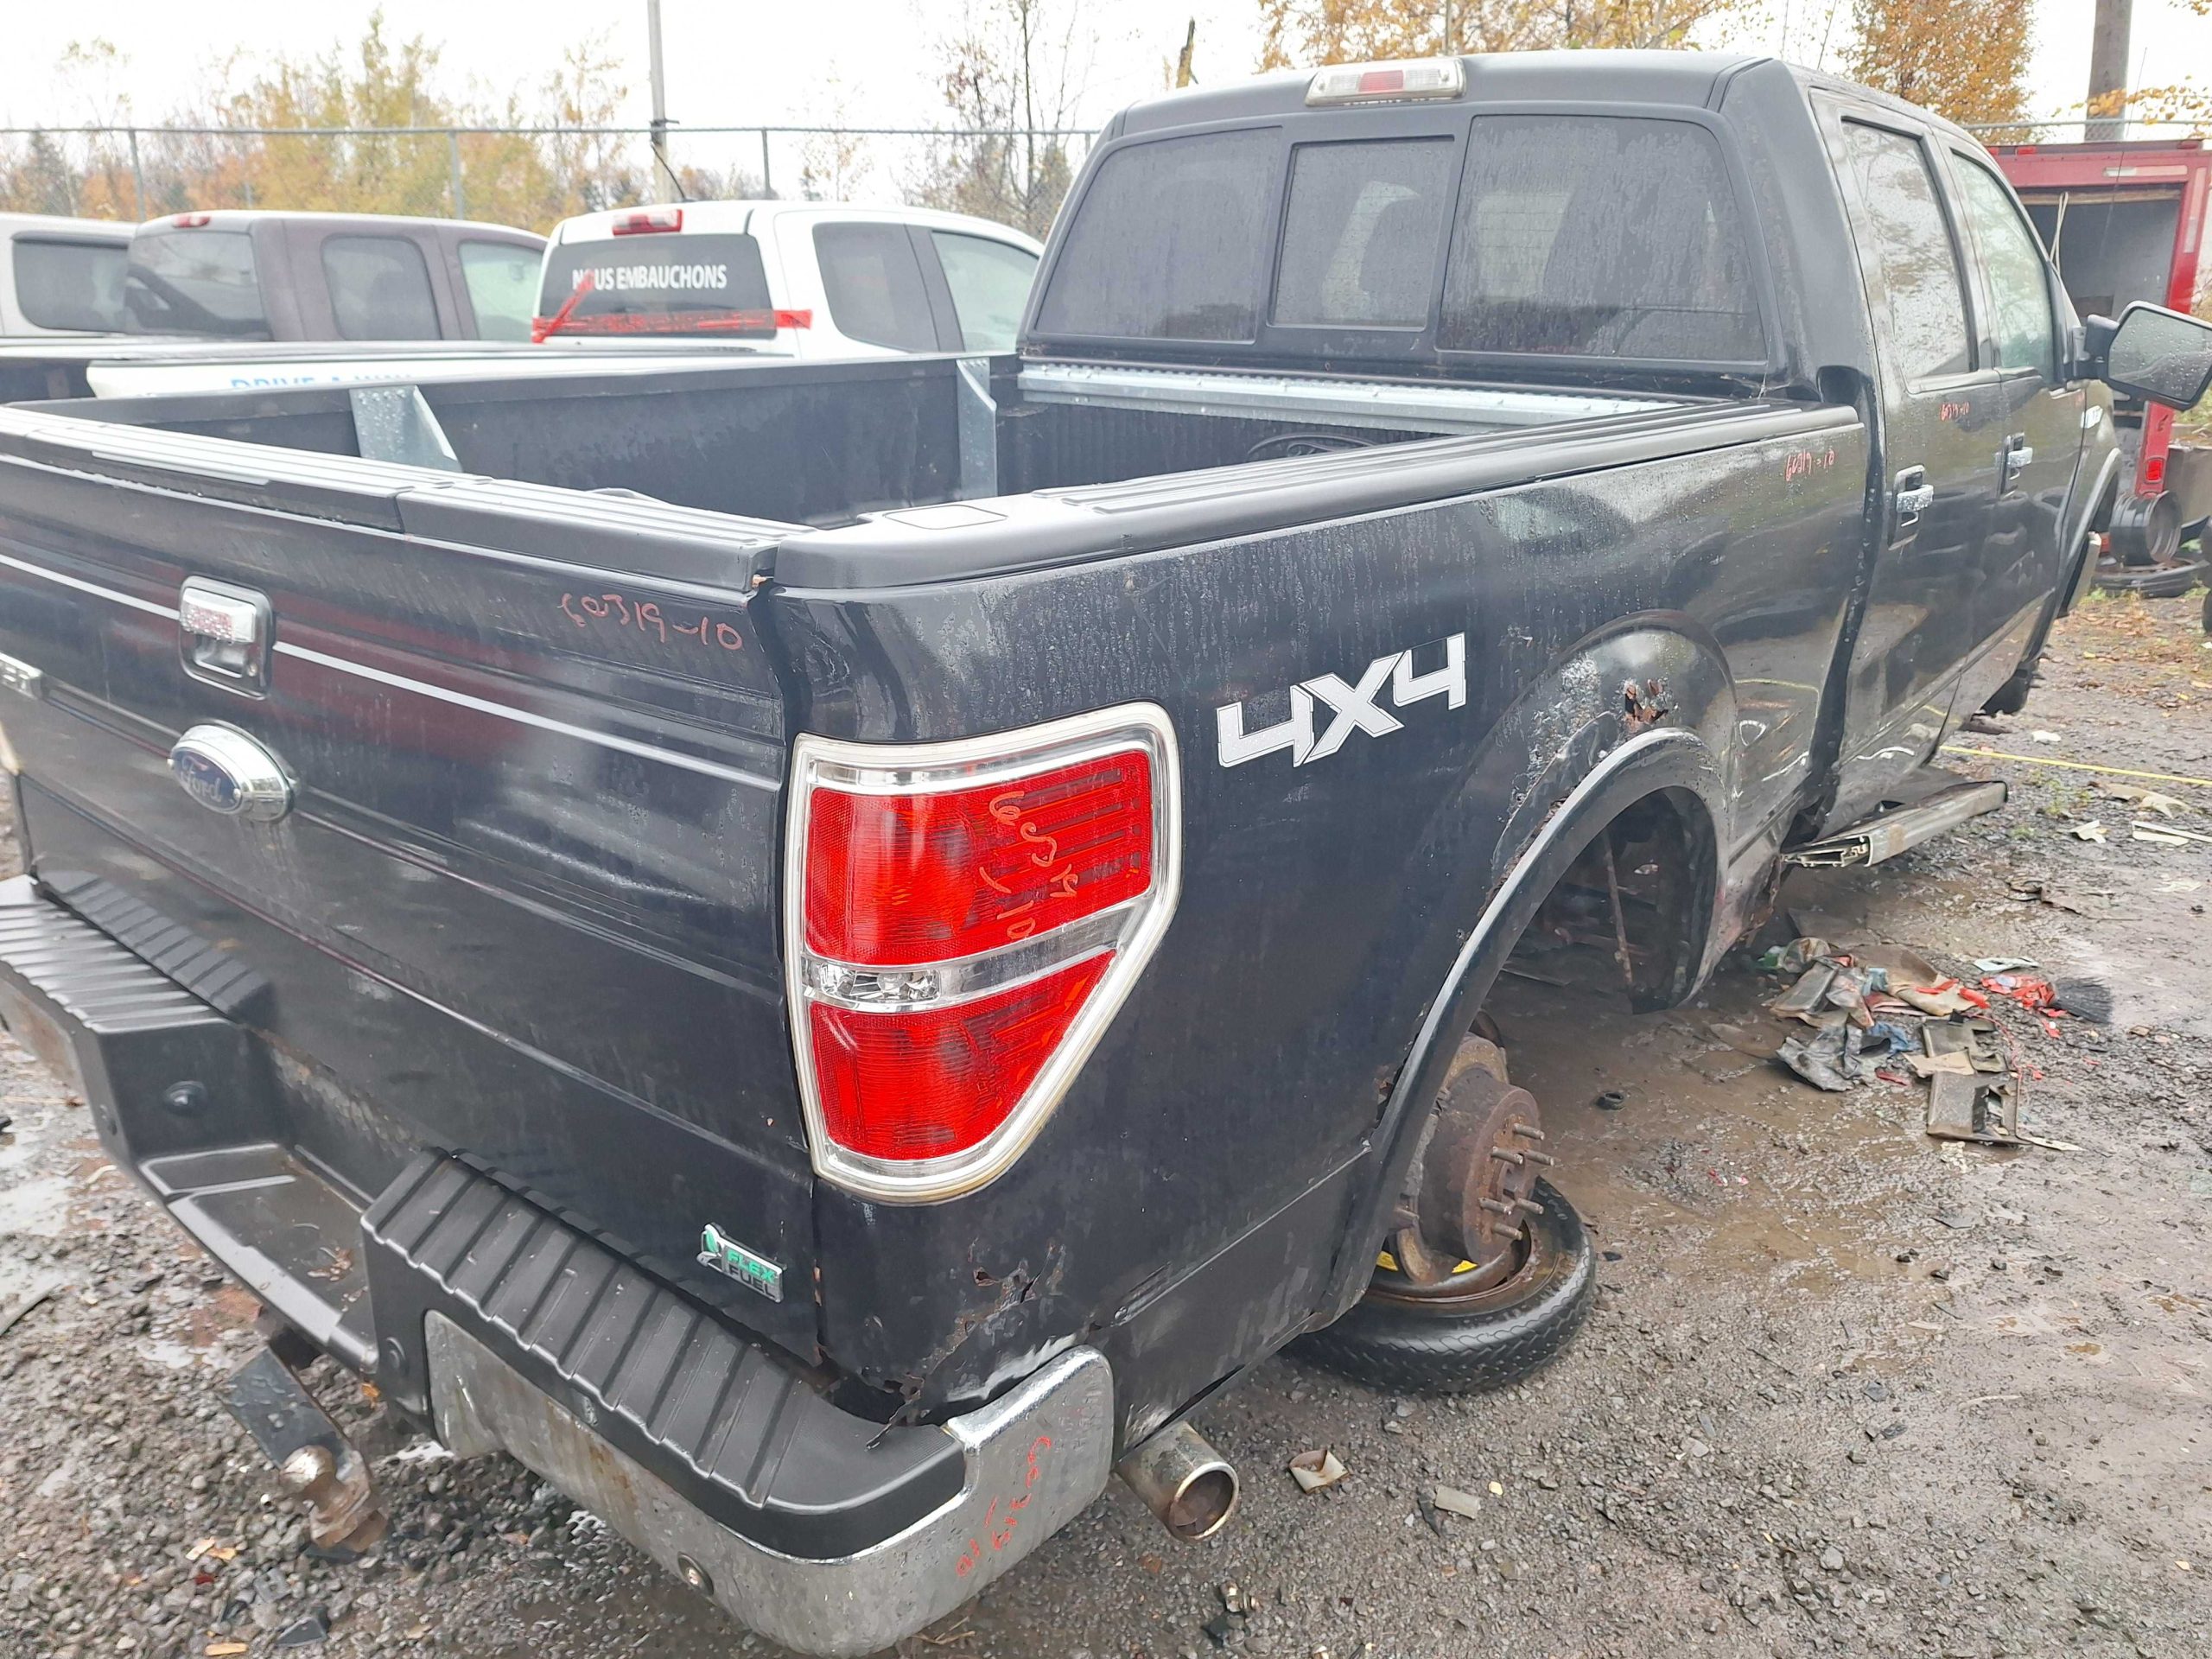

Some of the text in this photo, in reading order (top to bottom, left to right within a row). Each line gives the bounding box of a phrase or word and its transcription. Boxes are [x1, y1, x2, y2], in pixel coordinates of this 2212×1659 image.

[616, 264, 728, 289] EMBAUCHONS
[1216, 632, 1467, 768] 4X4
[180, 754, 223, 804] Ford
[727, 1249, 777, 1285] FLEX
[728, 1263, 777, 1299] FUEL
